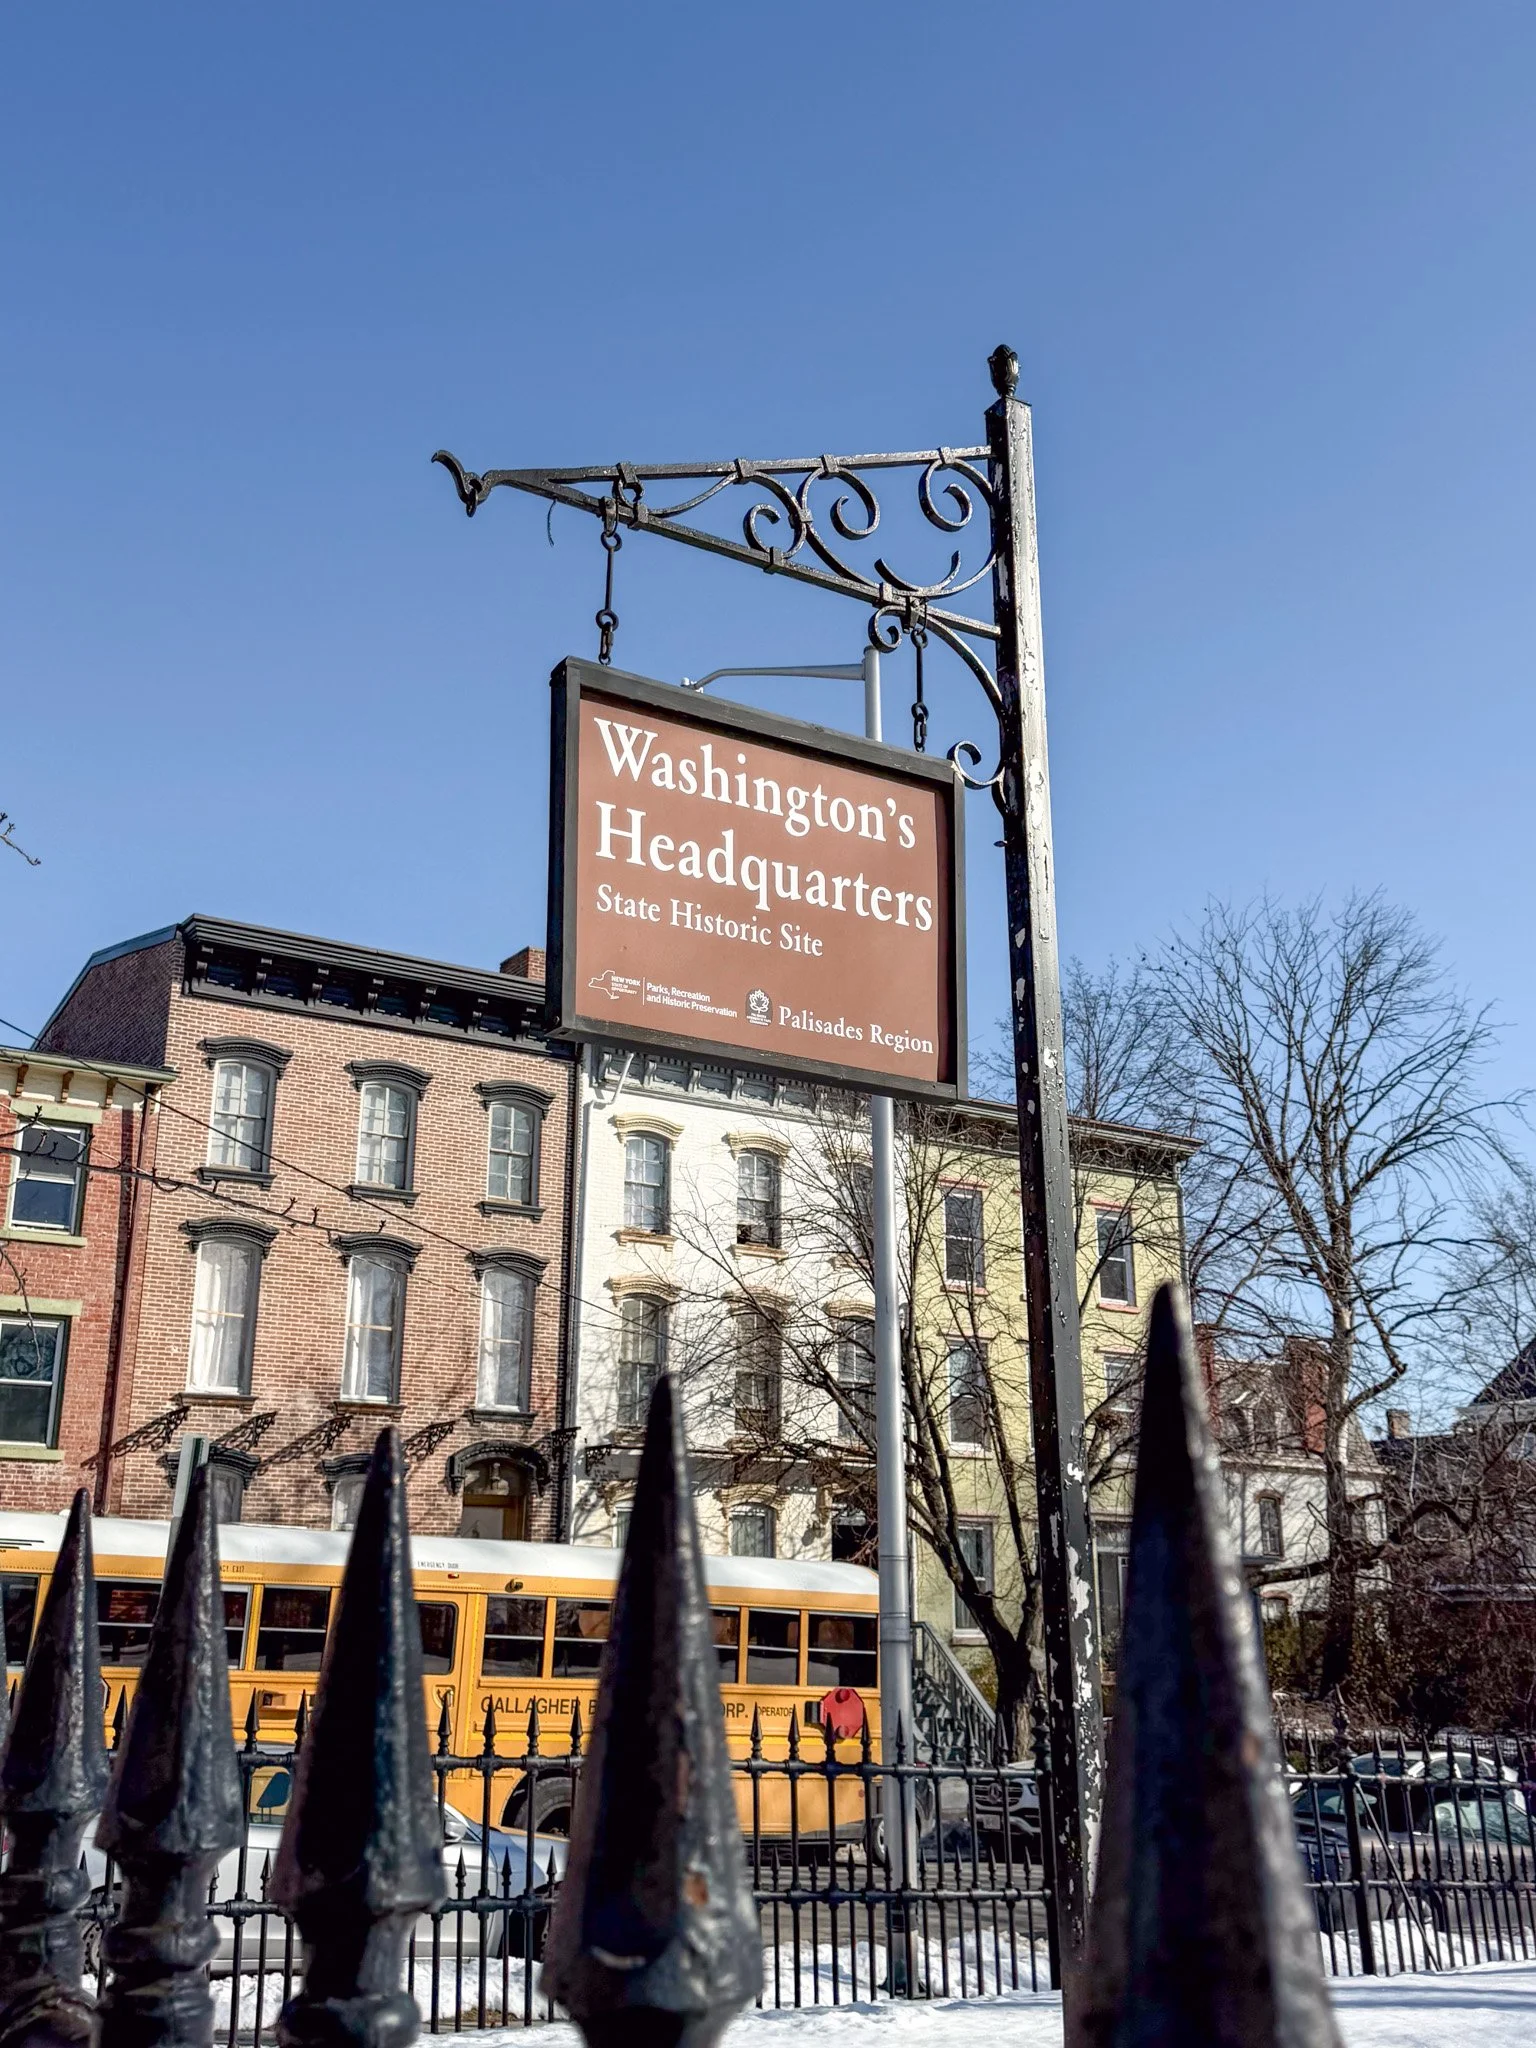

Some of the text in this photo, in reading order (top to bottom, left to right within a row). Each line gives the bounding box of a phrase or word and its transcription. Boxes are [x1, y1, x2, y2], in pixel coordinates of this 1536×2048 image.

[593, 717, 917, 849] Washington's
[595, 800, 934, 932] Headquarters
[596, 883, 824, 957] State Historic Site
[611, 975, 641, 987] NEW YORK
[646, 982, 711, 1003] Parks, Recreation
[646, 993, 738, 1018] and Historic Preservation
[778, 1005, 934, 1054] Palisades Region
